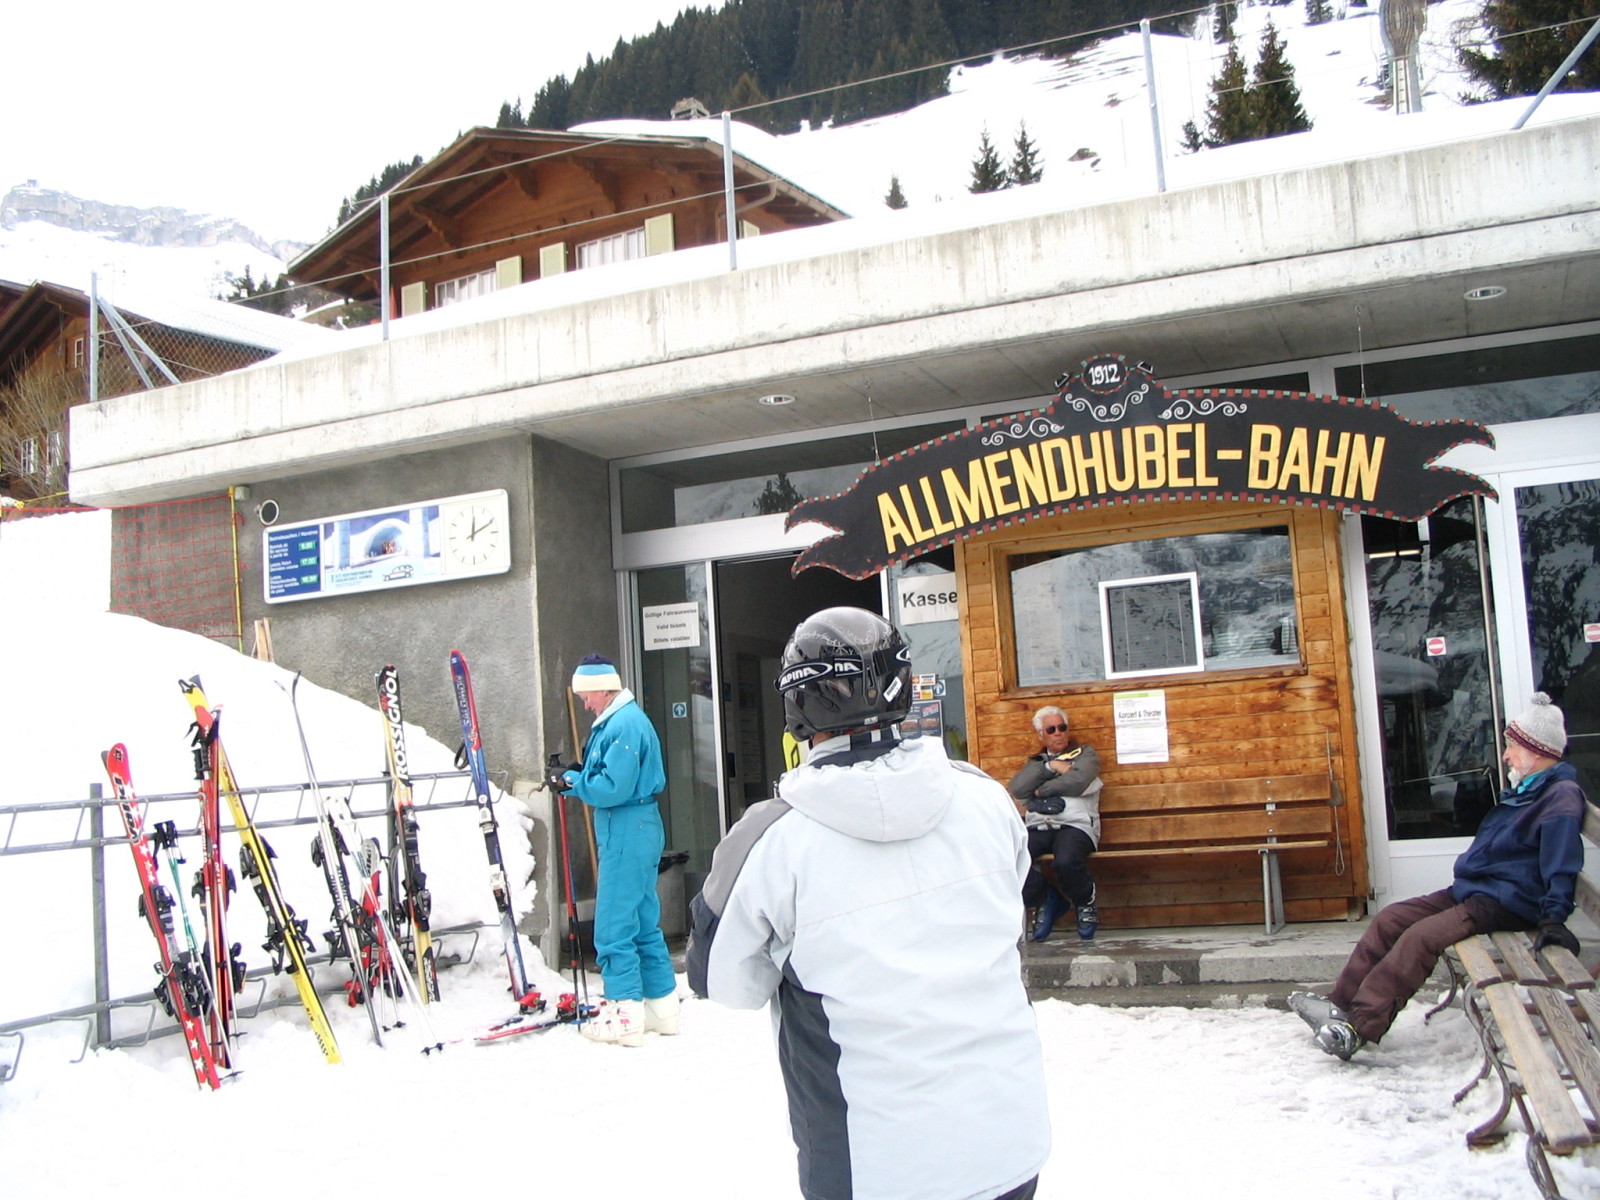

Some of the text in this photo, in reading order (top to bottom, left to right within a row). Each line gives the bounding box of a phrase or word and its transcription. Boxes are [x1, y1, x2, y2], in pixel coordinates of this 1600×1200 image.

[1089, 363, 1120, 386] 1912
[876, 422, 1386, 554] ALLMENDHUBEL-BAHN
[902, 591, 958, 608] Kasse
[385, 669, 409, 780] ROSSIGNOL
